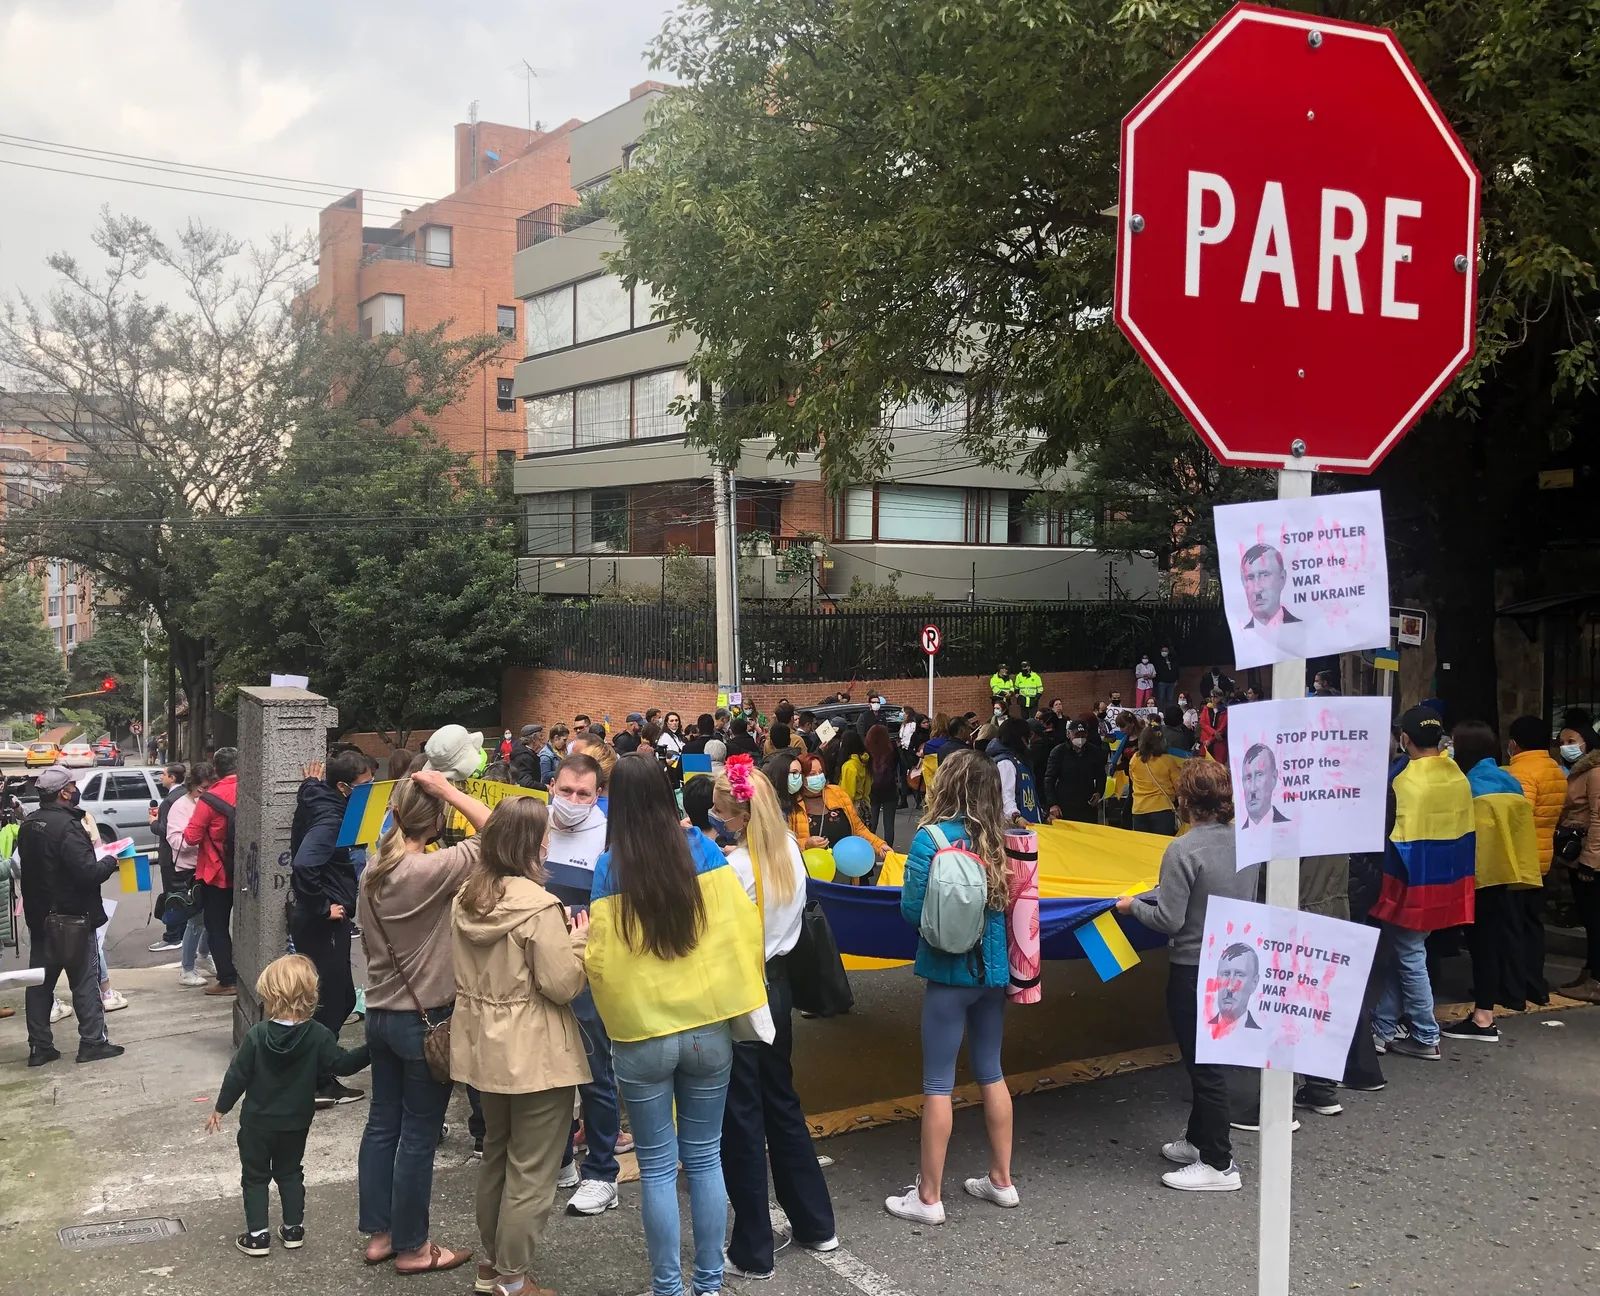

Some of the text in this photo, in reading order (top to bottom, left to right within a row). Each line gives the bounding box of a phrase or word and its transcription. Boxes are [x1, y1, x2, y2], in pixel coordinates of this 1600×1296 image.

[1185, 170, 1422, 320] PARE
[1283, 525, 1366, 544] STOP PUTLER
[1292, 556, 1346, 570] STOP the
[1292, 574, 1321, 587] WAR
[1294, 585, 1366, 604] IN UKRAINE
[1276, 730, 1369, 744] STOP PUTLER
[1283, 757, 1340, 770] STOP the
[1283, 774, 1310, 787] WAR
[1283, 788, 1361, 803] IN UKRAINE
[1262, 939, 1351, 966] STOP PUTLER
[1265, 968, 1319, 986] STOP the
[1262, 984, 1287, 997] WAR
[1259, 1000, 1332, 1022] IN UKRAINE
